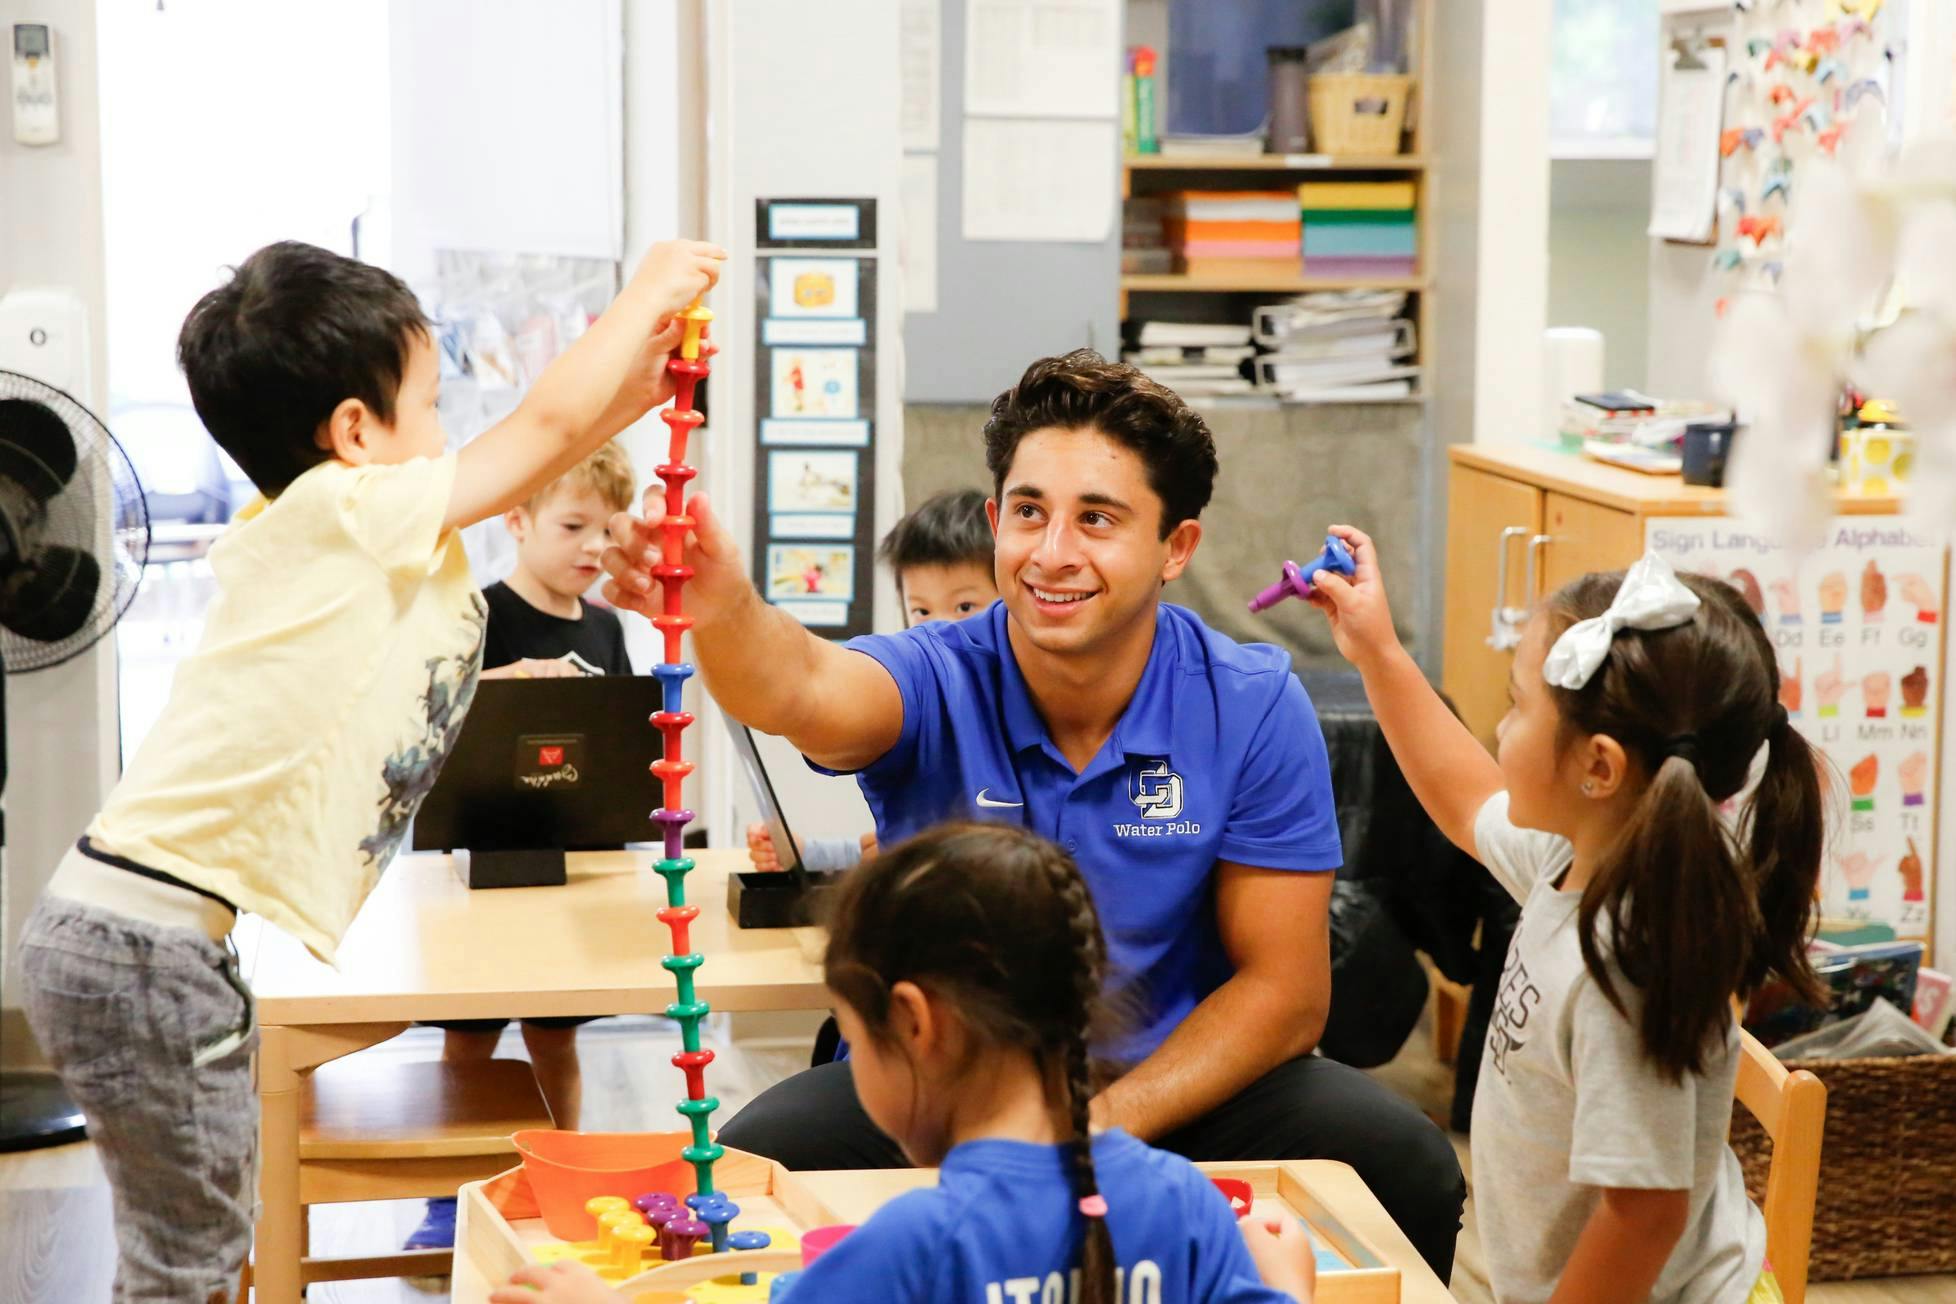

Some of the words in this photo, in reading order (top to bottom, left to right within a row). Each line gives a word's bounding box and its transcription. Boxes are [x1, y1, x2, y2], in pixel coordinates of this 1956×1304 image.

[1652, 530, 1704, 553] Sign
[1835, 528, 1935, 550] Alphab
[1819, 630, 1846, 647] Ee
[1113, 823, 1163, 837] Water
[1166, 821, 1200, 835] Polo
